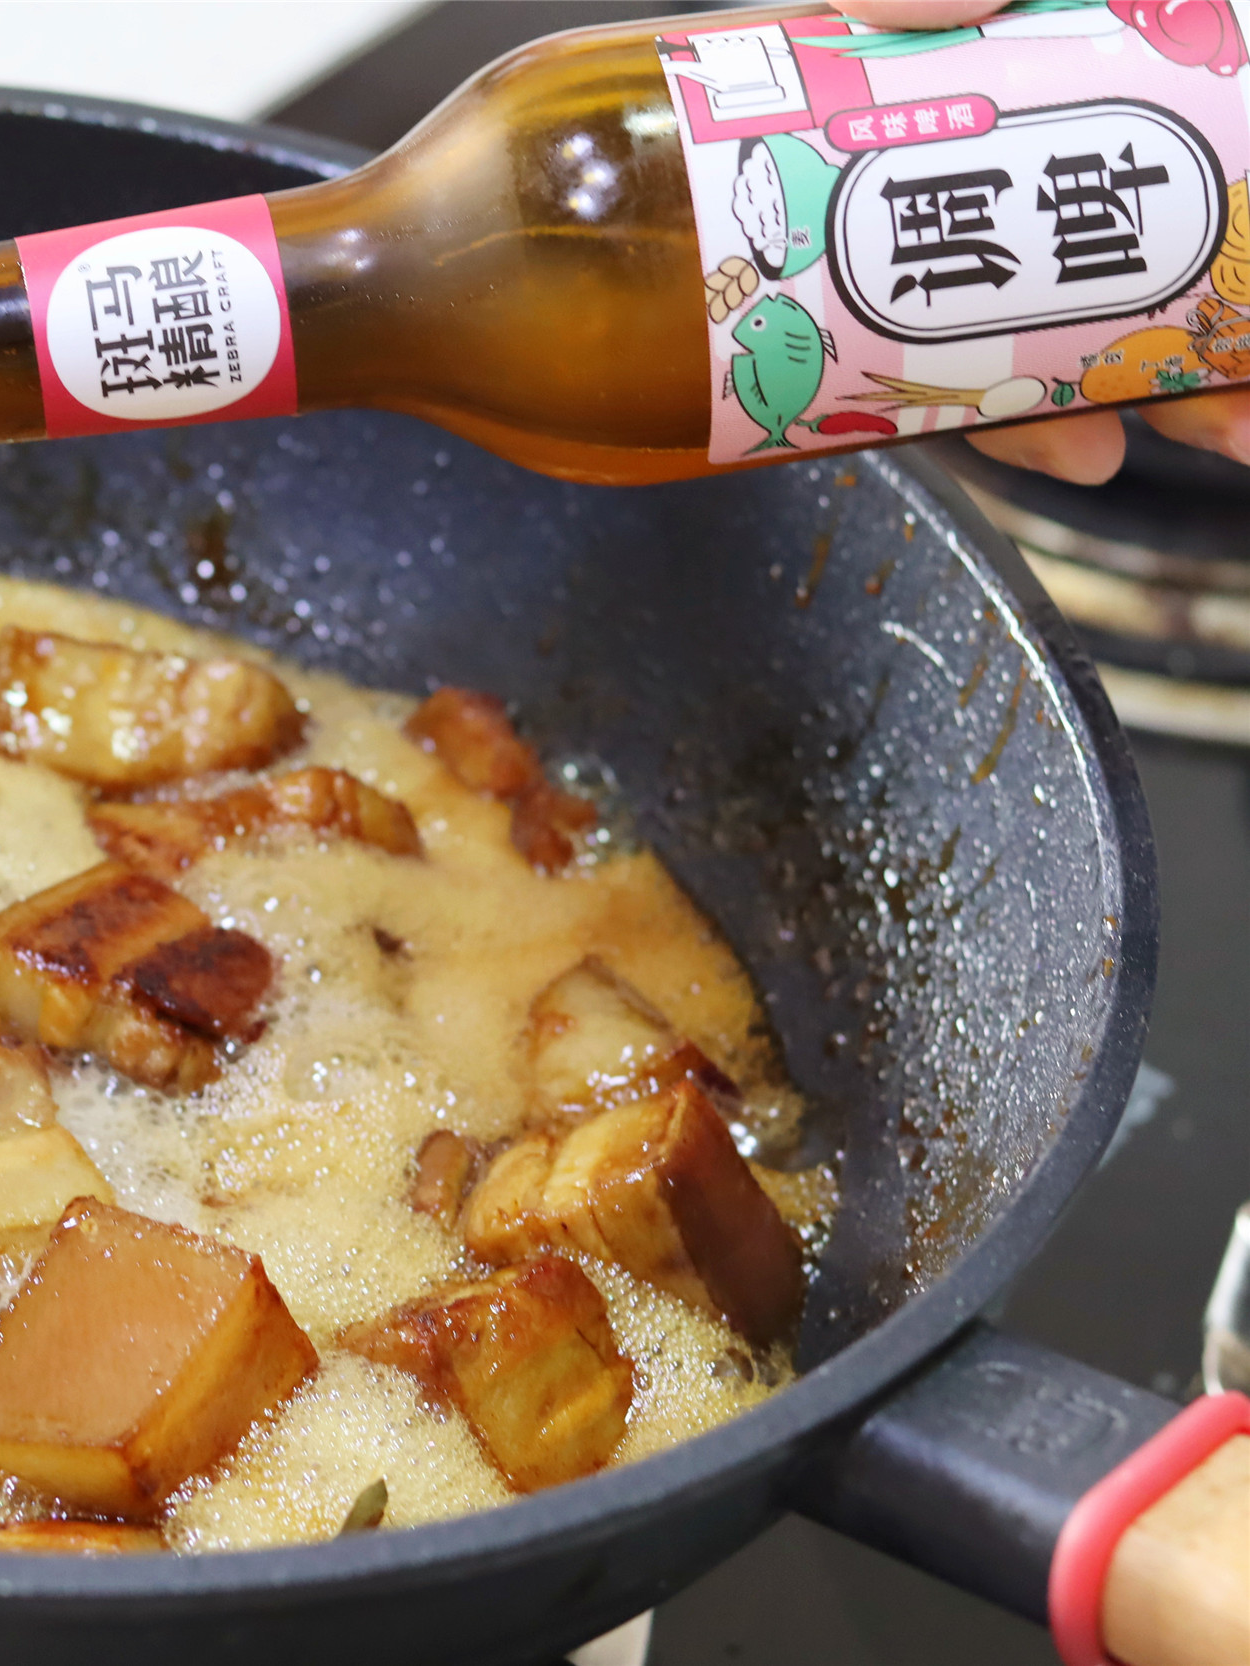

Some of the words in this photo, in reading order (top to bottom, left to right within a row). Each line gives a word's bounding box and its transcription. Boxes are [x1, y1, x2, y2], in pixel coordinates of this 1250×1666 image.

[848, 103, 976, 142] 风味啤酒
[882, 141, 1170, 307] 调啤
[149, 250, 221, 389] 精酿
[211, 248, 232, 312] CRAFT
[85, 264, 164, 398] 斑马
[223, 320, 243, 384] ZEBRA
